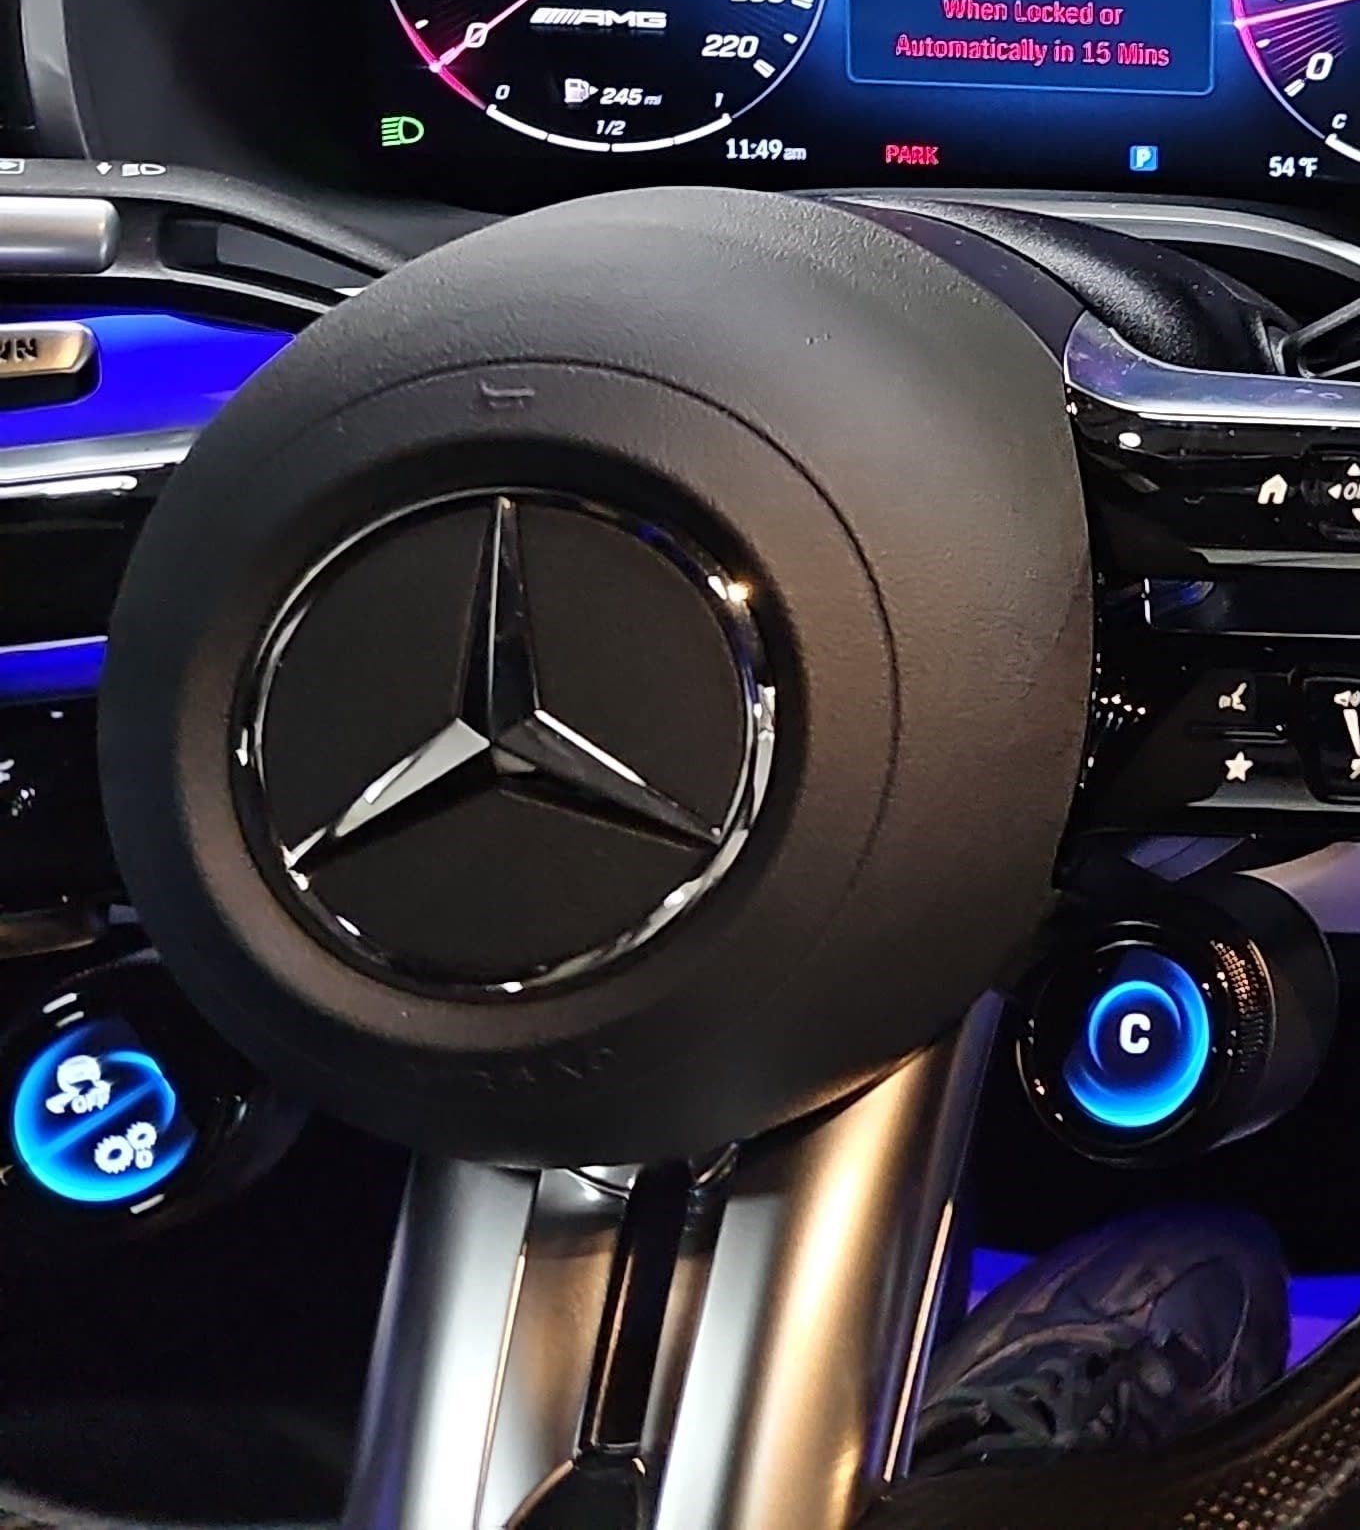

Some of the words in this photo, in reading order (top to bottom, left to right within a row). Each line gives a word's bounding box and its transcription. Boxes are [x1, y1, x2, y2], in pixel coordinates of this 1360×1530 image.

[578, 8, 667, 28] AMG
[1013, 0, 1094, 25] Locked
[1099, 7, 1123, 25] or
[464, 23, 489, 48] 0
[702, 35, 758, 58] 220
[895, 33, 1048, 67] Automatically
[1053, 41, 1075, 62] in
[1081, 41, 1112, 64] 15
[1117, 42, 1170, 67] Mins
[1305, 50, 1334, 81] 0
[495, 84, 511, 100] 0
[600, 88, 643, 106] 245
[596, 120, 626, 136] 1/2
[885, 144, 940, 167] PARK
[1118, 1012, 1151, 1054] C
